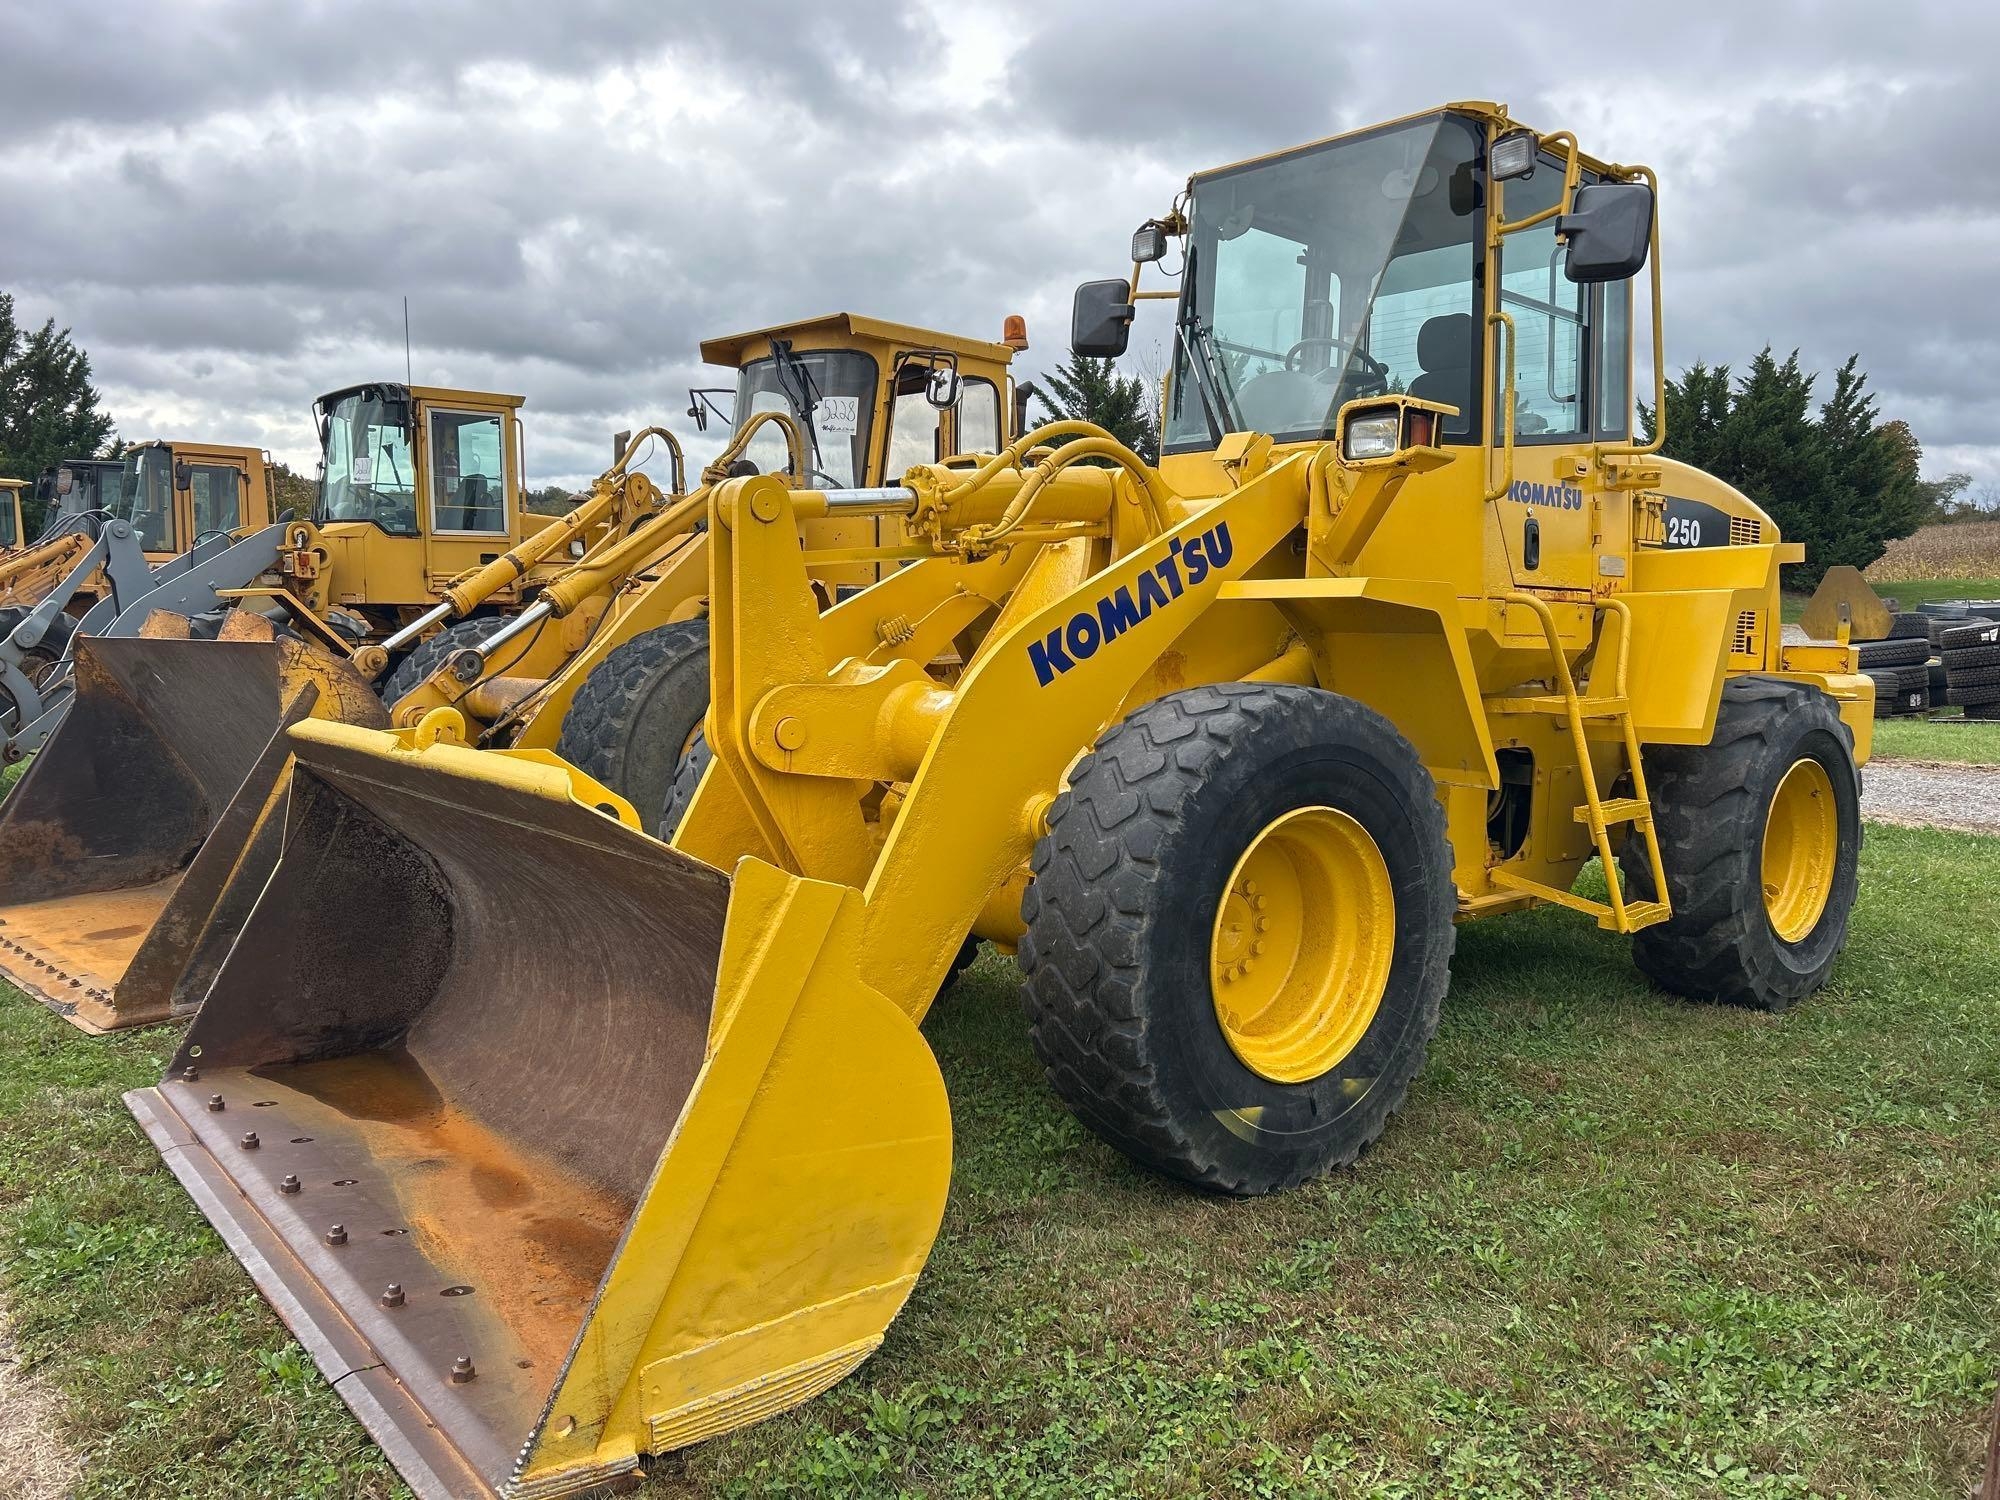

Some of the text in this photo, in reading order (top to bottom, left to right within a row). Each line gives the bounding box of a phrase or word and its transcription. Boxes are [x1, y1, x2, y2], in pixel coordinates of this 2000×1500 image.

[824, 399, 856, 422] 5228
[1507, 479, 1583, 511] KOMATSU
[1027, 520, 1233, 688] KOMATSU
